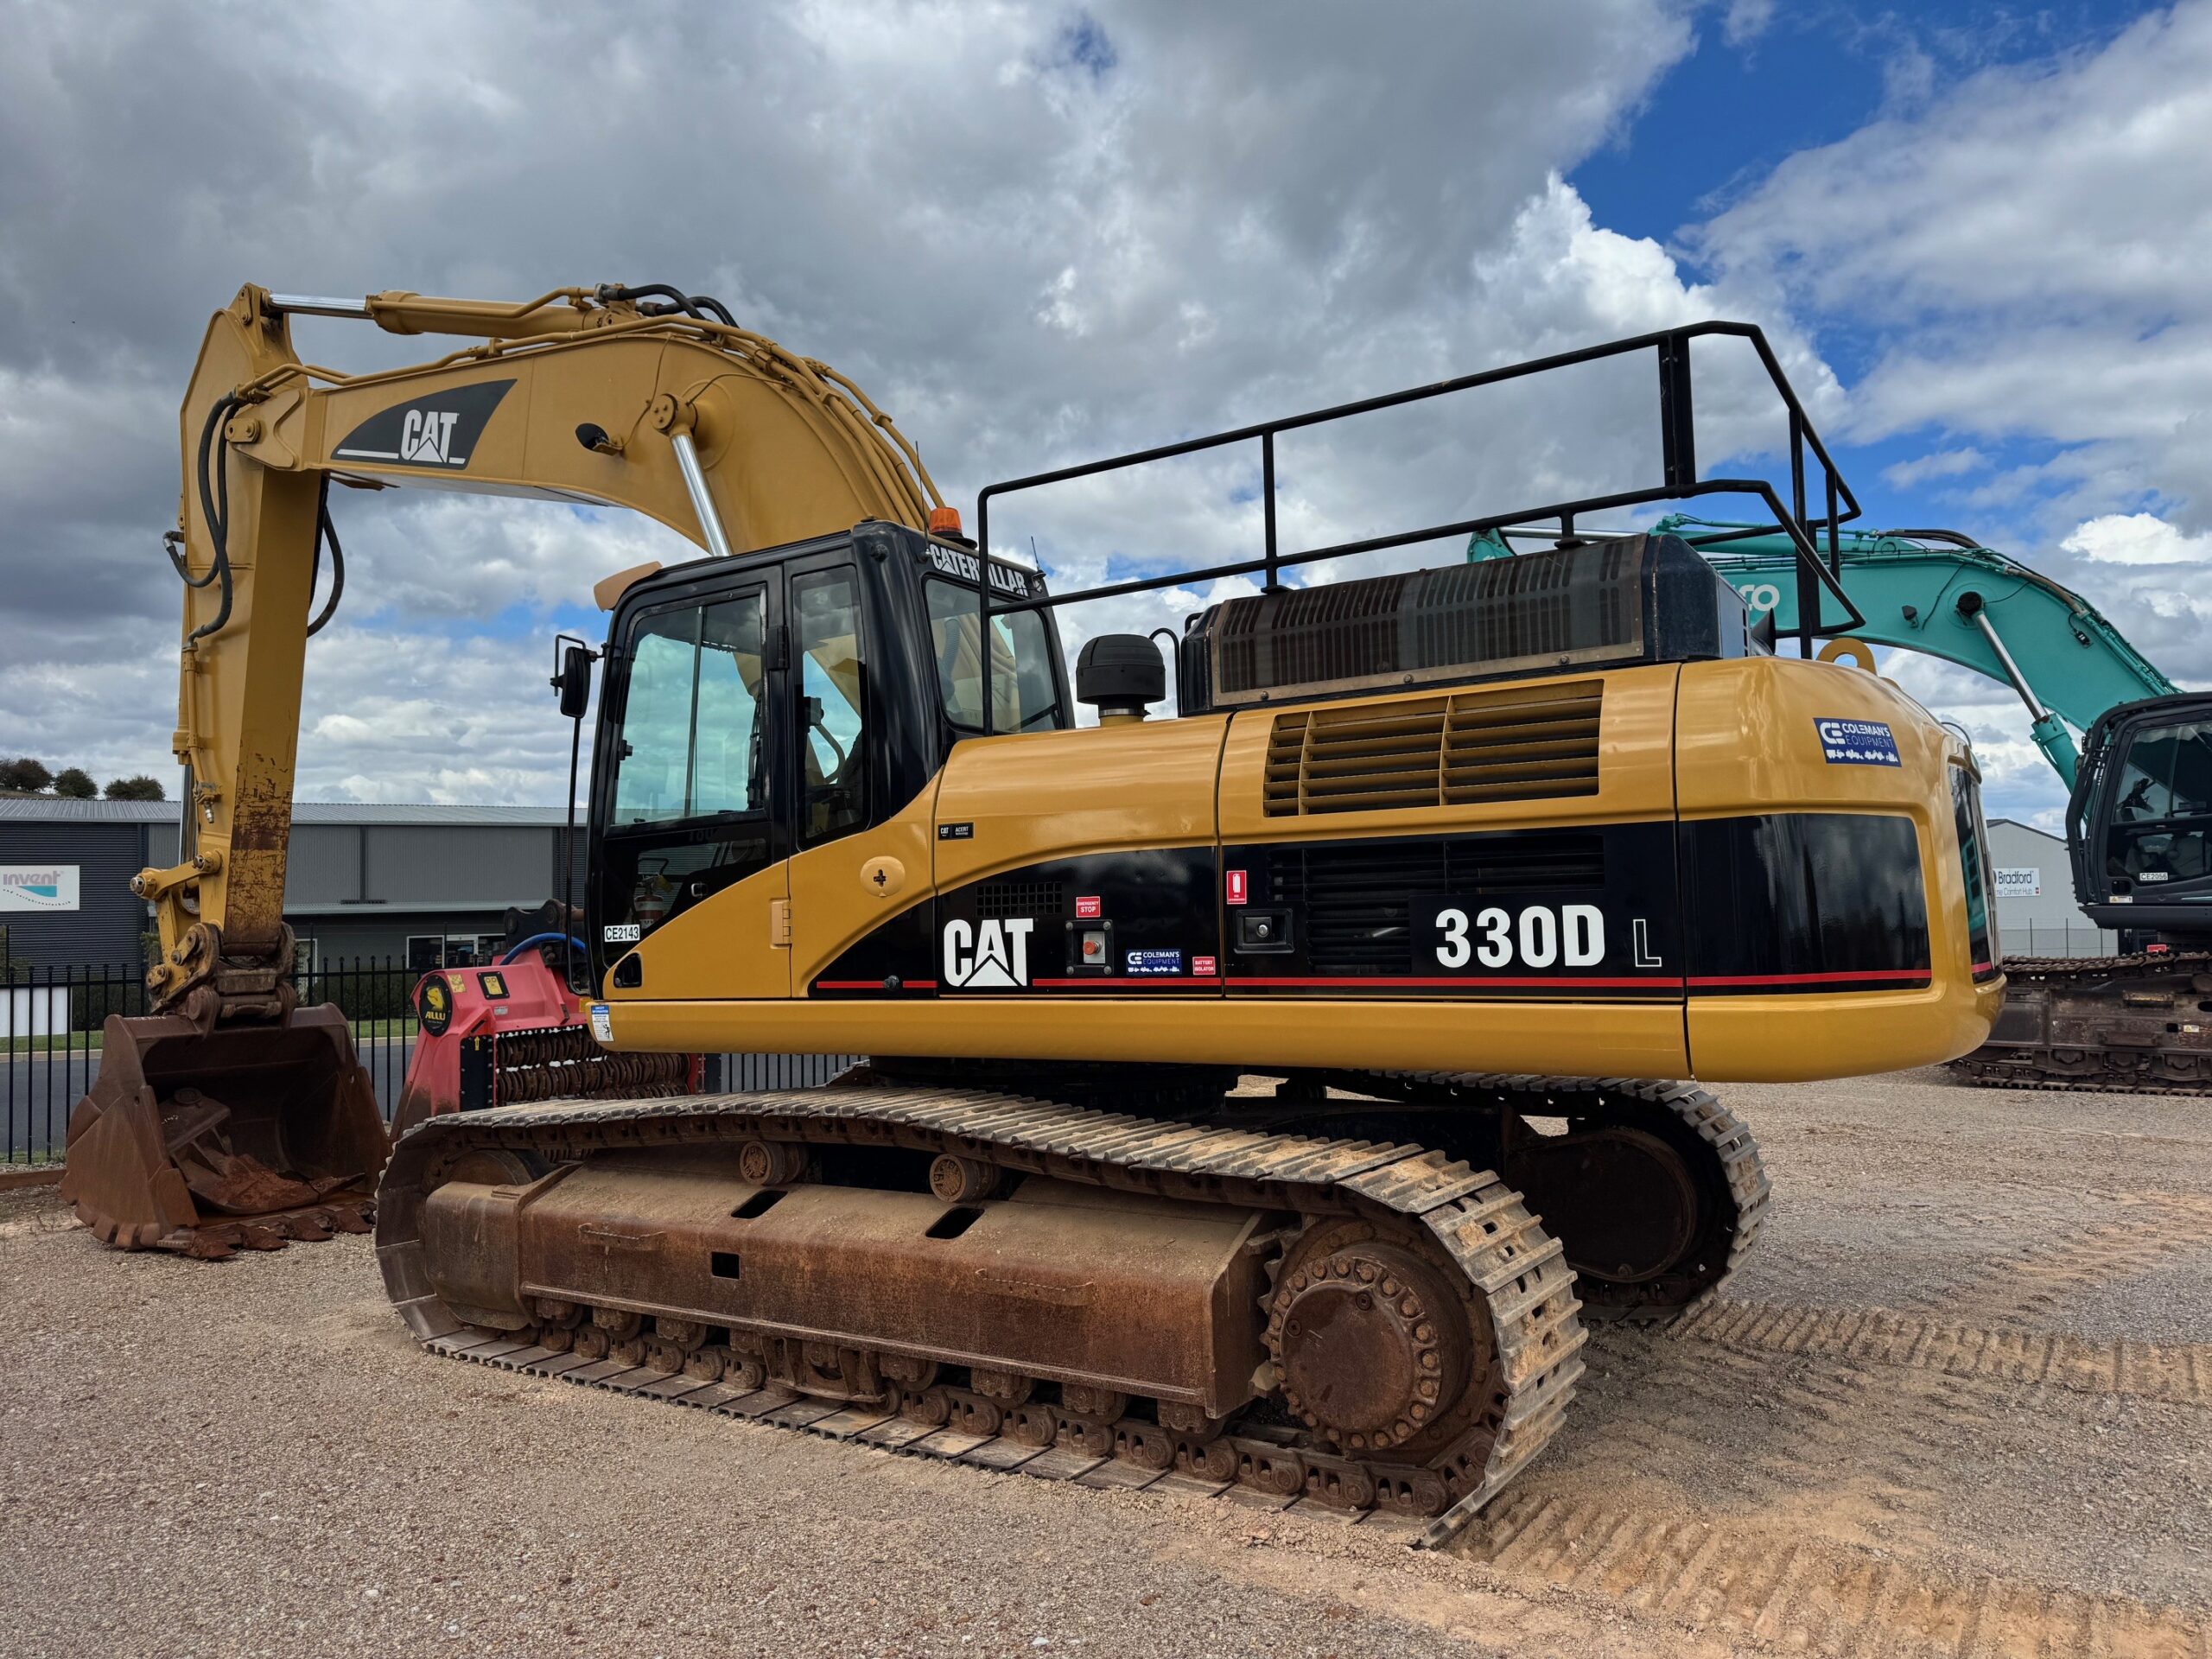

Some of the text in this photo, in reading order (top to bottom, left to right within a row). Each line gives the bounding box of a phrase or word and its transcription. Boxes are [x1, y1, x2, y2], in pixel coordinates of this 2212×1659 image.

[401, 409, 459, 463] CAT
[930, 543, 1029, 597] CATERILLAR
[1841, 722, 1891, 737] COLEMAN'S
[1845, 734, 1894, 748] EQUIPMENT
[3, 870, 60, 886] invent
[1998, 870, 2032, 885] Bradford
[606, 926, 639, 941] CE2143
[1435, 905, 1662, 968] 330D L
[944, 918, 1033, 987] CAT
[424, 1011, 446, 1021] ALLU
